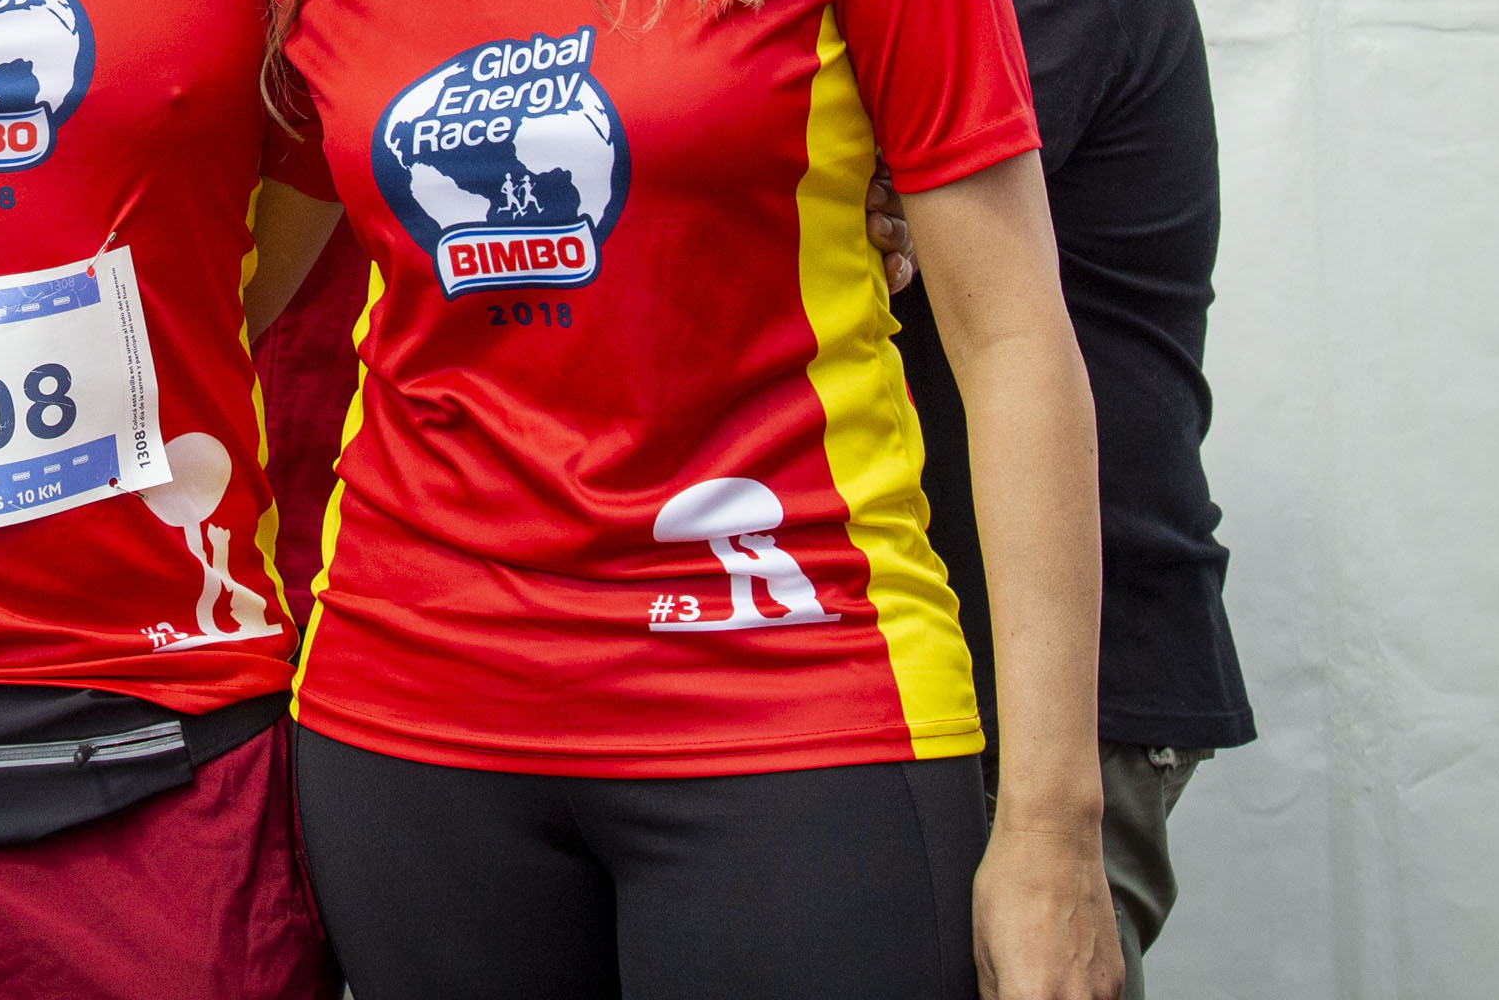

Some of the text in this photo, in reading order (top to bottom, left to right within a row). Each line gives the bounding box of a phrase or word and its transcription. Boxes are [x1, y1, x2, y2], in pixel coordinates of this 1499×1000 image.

[472, 30, 590, 82] Global
[437, 72, 581, 116] Energy
[413, 116, 512, 155] Race
[448, 236, 586, 278] BIMBO
[487, 302, 572, 328] 2018
[134, 430, 151, 469] 1308
[16, 489, 34, 505] 10
[38, 482, 62, 500] KM
[648, 594, 701, 622] #3
